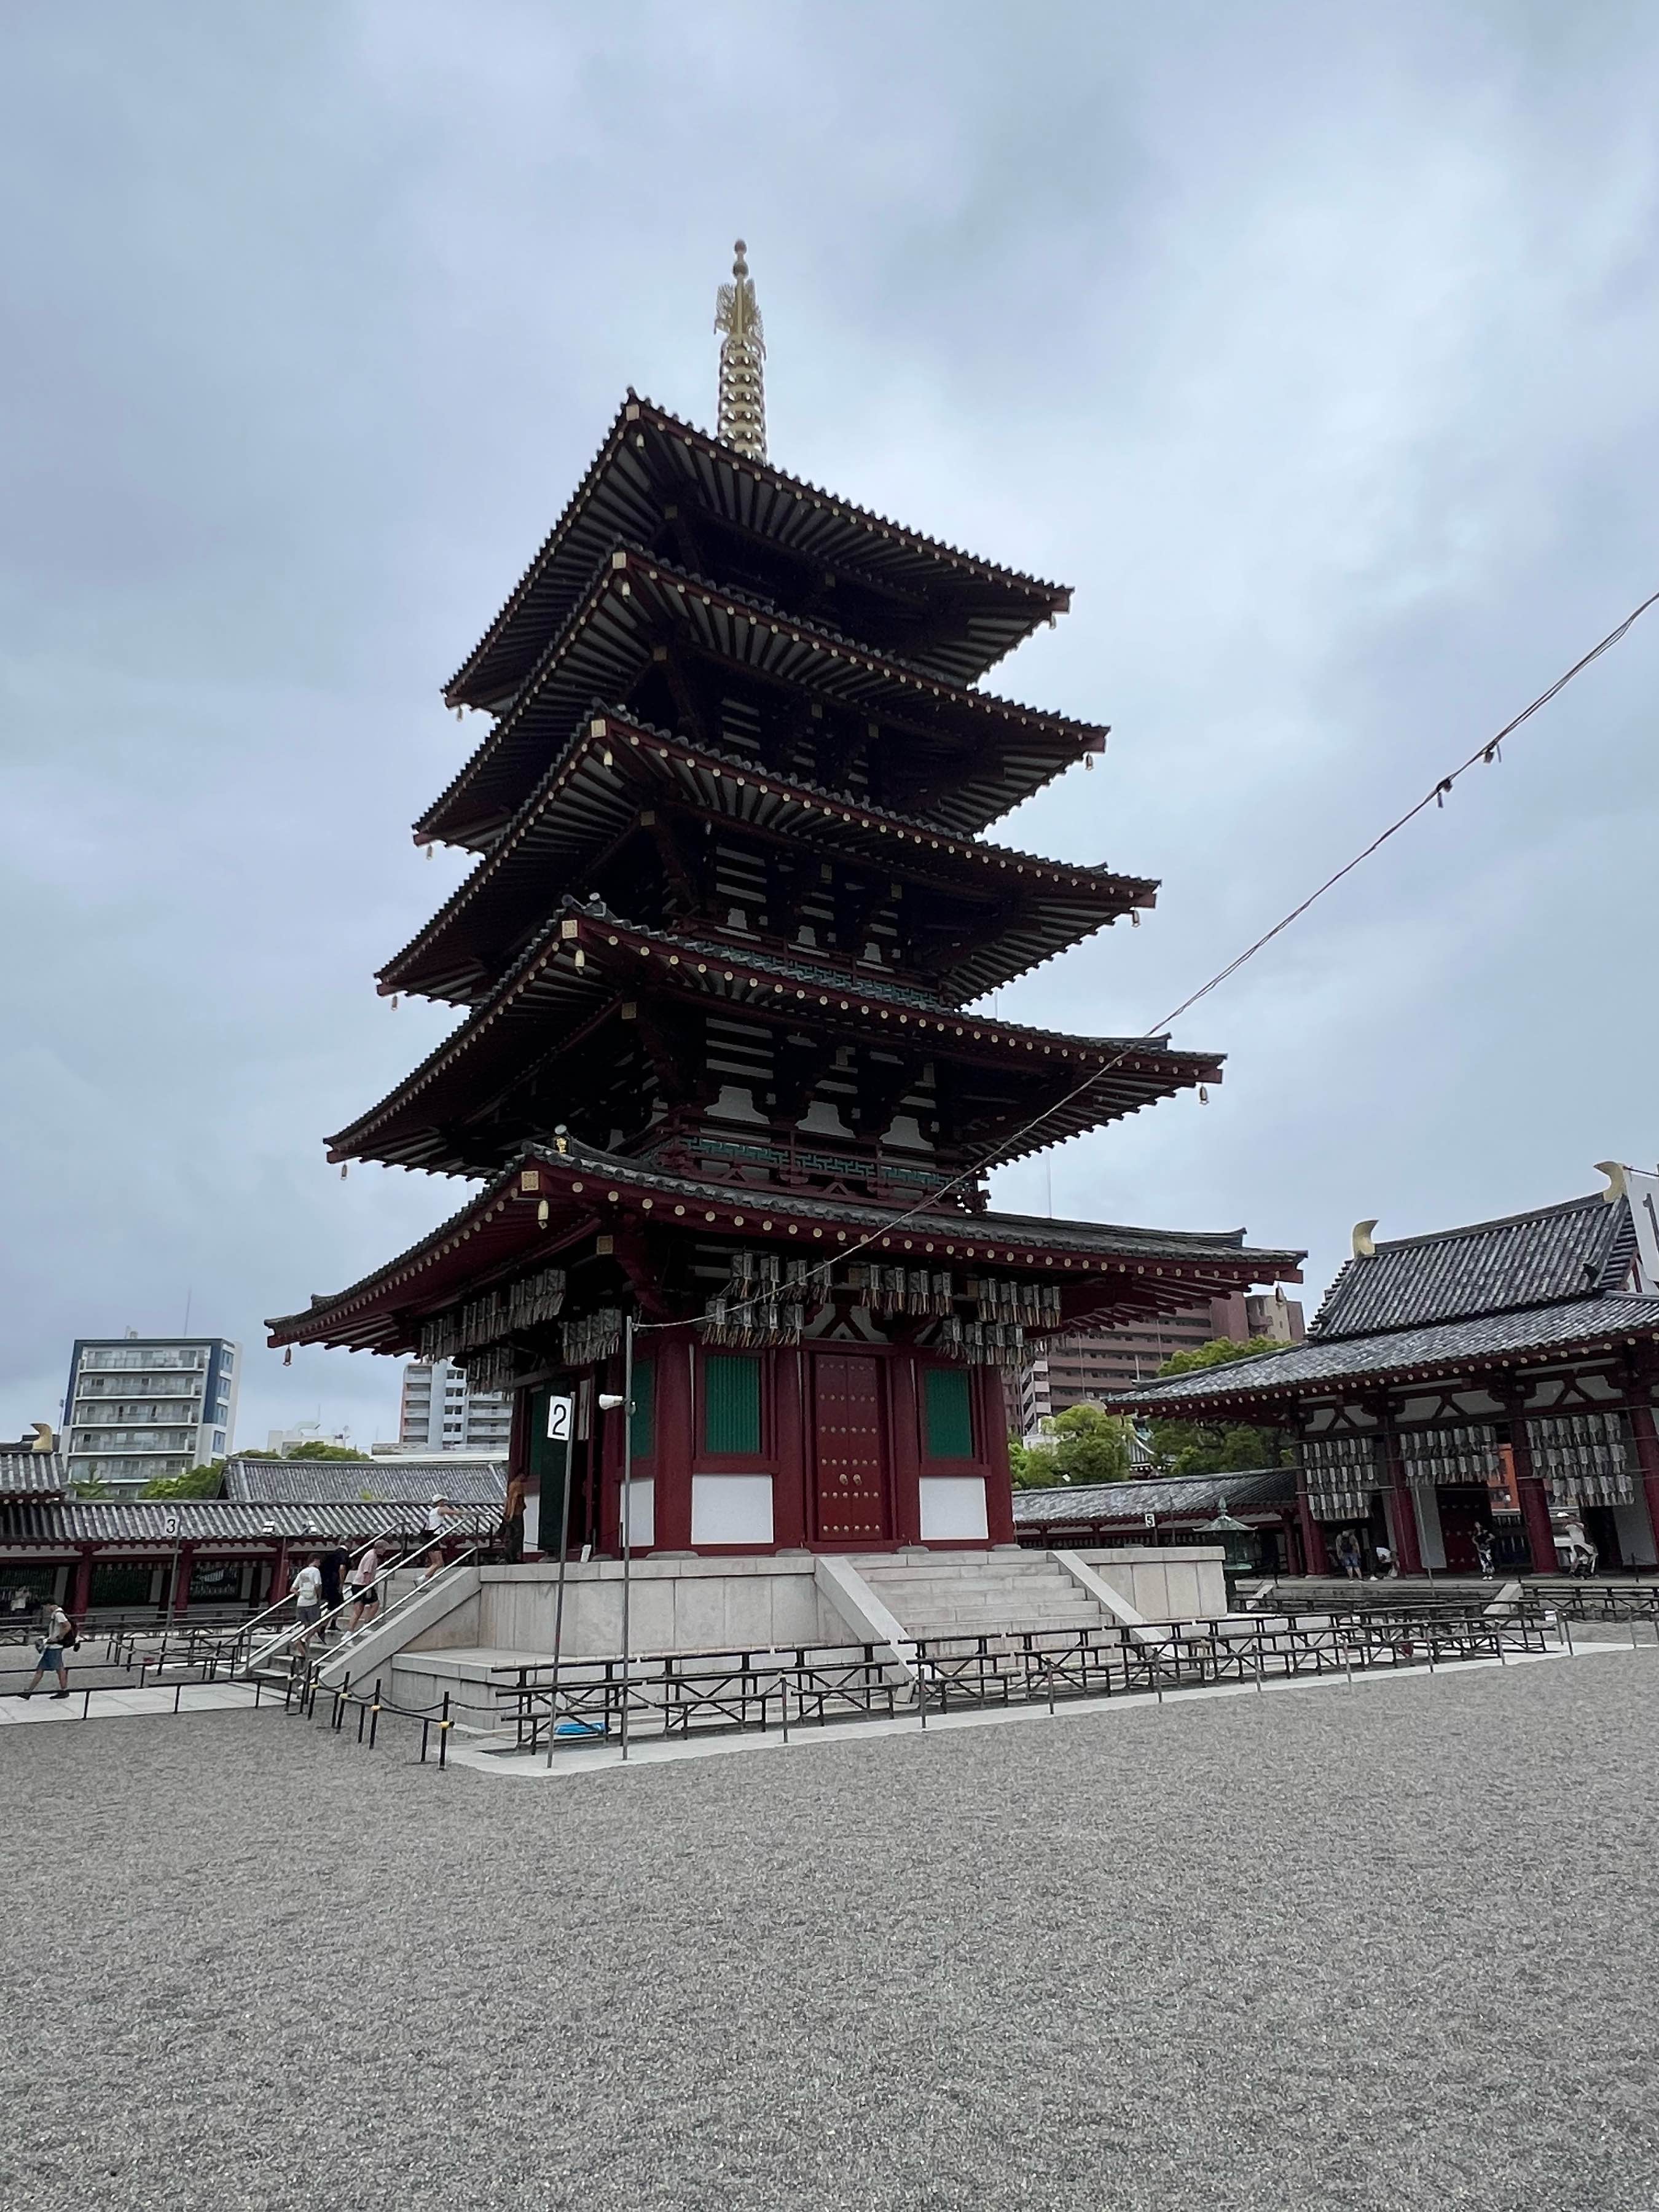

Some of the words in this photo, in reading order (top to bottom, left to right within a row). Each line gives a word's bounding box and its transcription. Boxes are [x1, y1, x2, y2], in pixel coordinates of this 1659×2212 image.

[552, 1404, 566, 1436] 2
[166, 1519, 176, 1534] 3
[1147, 1515, 1153, 1526] 5
